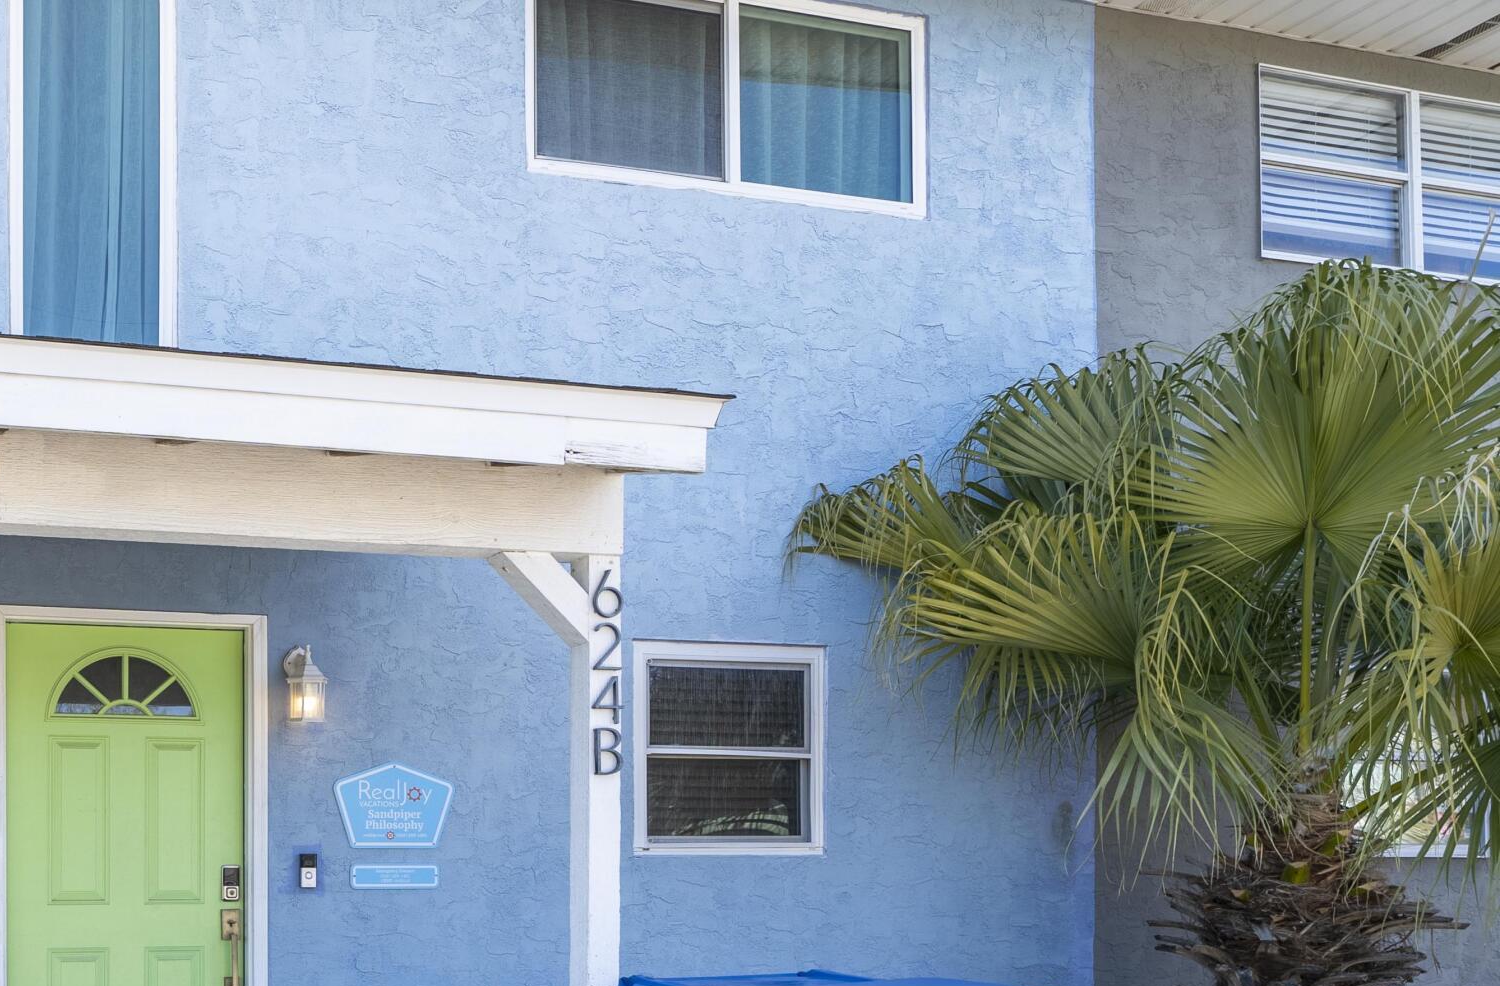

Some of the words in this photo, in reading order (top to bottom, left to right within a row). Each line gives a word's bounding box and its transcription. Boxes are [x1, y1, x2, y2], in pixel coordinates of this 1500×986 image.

[591, 569, 625, 776] 624B
[359, 800, 401, 808] VACATIONS
[367, 809, 422, 821] Sandpiper
[365, 820, 424, 832] Philosophy
